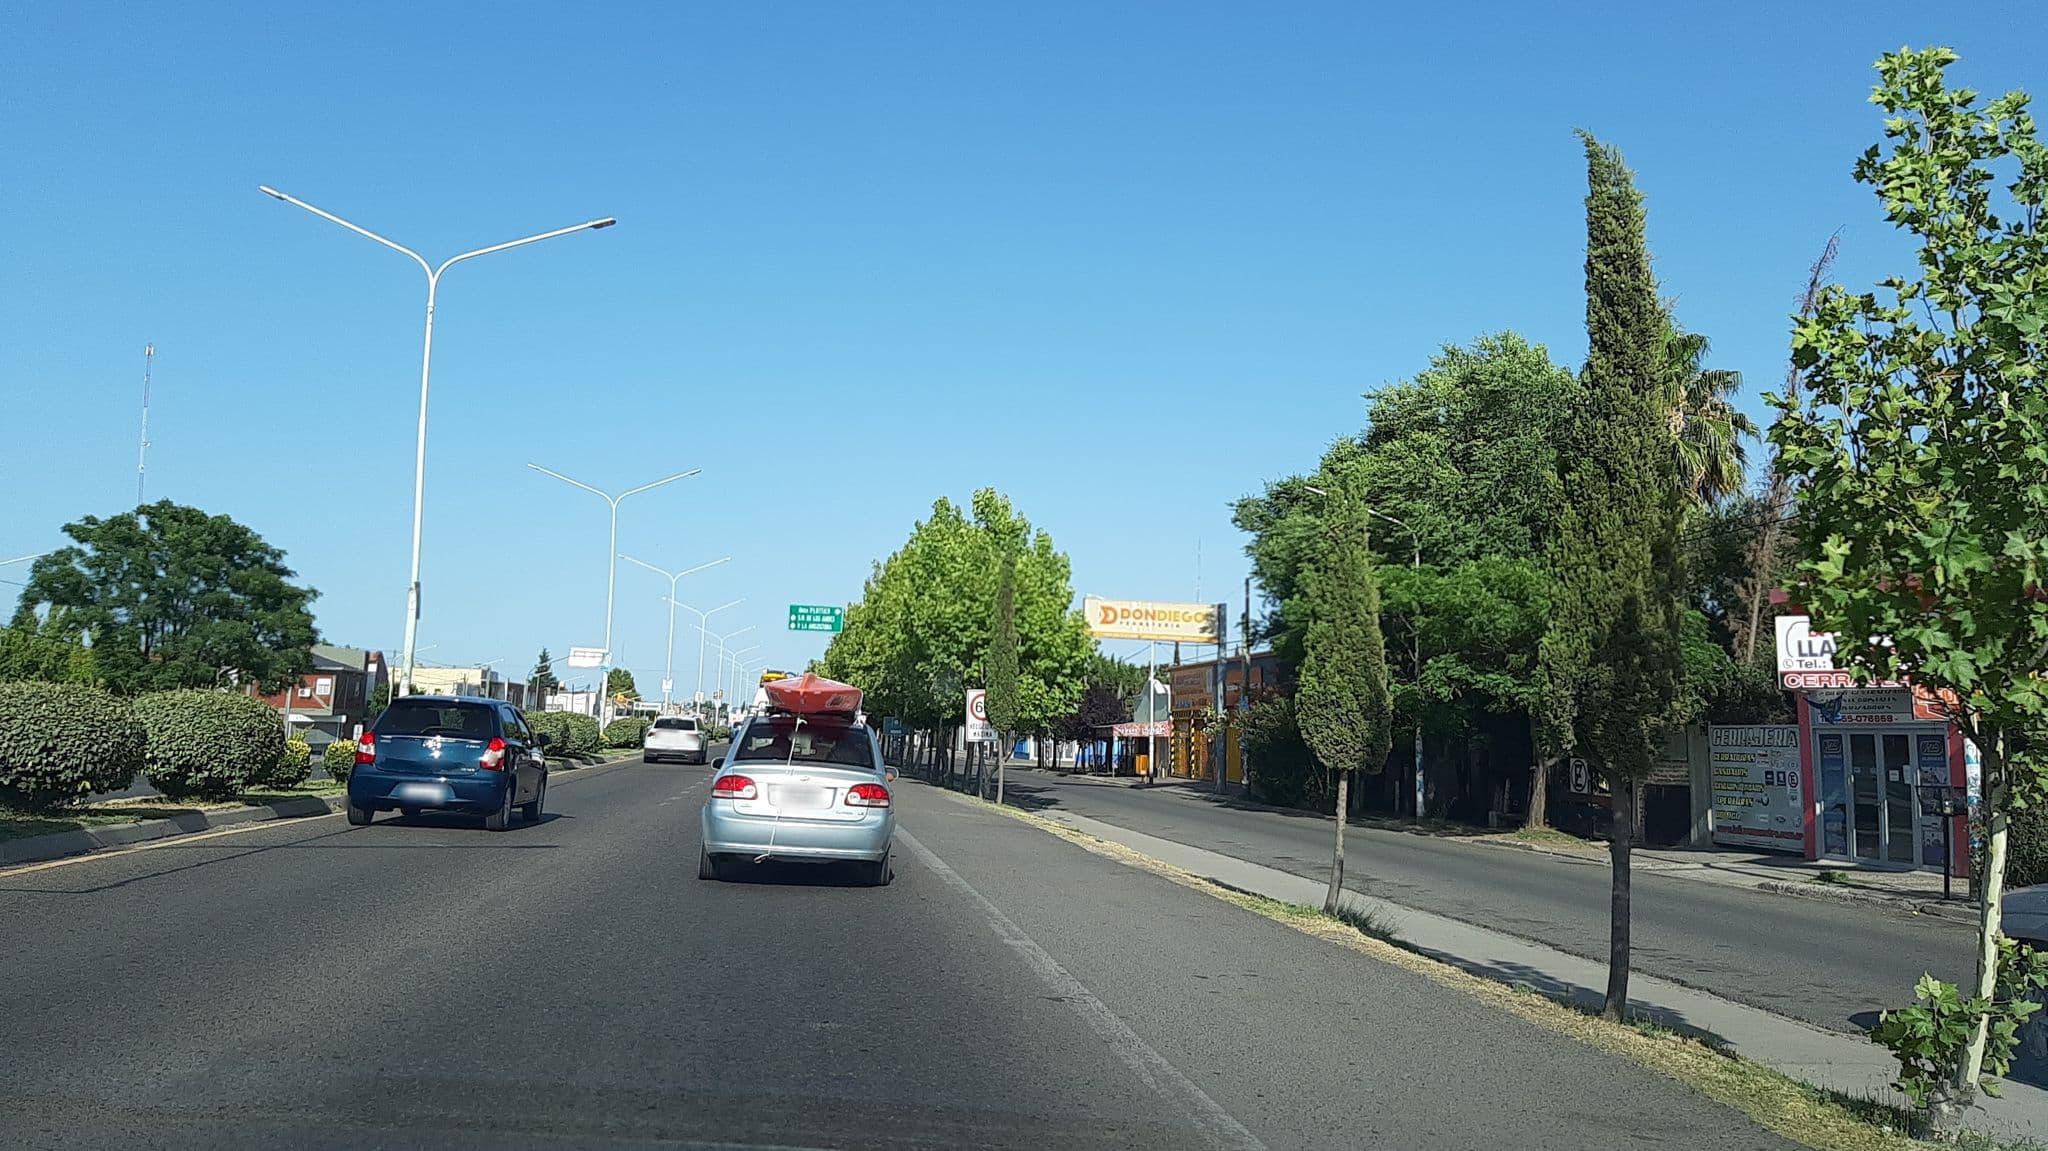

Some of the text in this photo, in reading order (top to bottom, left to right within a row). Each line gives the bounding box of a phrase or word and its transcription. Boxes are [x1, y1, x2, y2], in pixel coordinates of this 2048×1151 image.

[1796, 639, 1833, 658] LLA
[1796, 659, 1827, 669] Tel.:
[1711, 728, 1798, 748] CERRAJERIA
